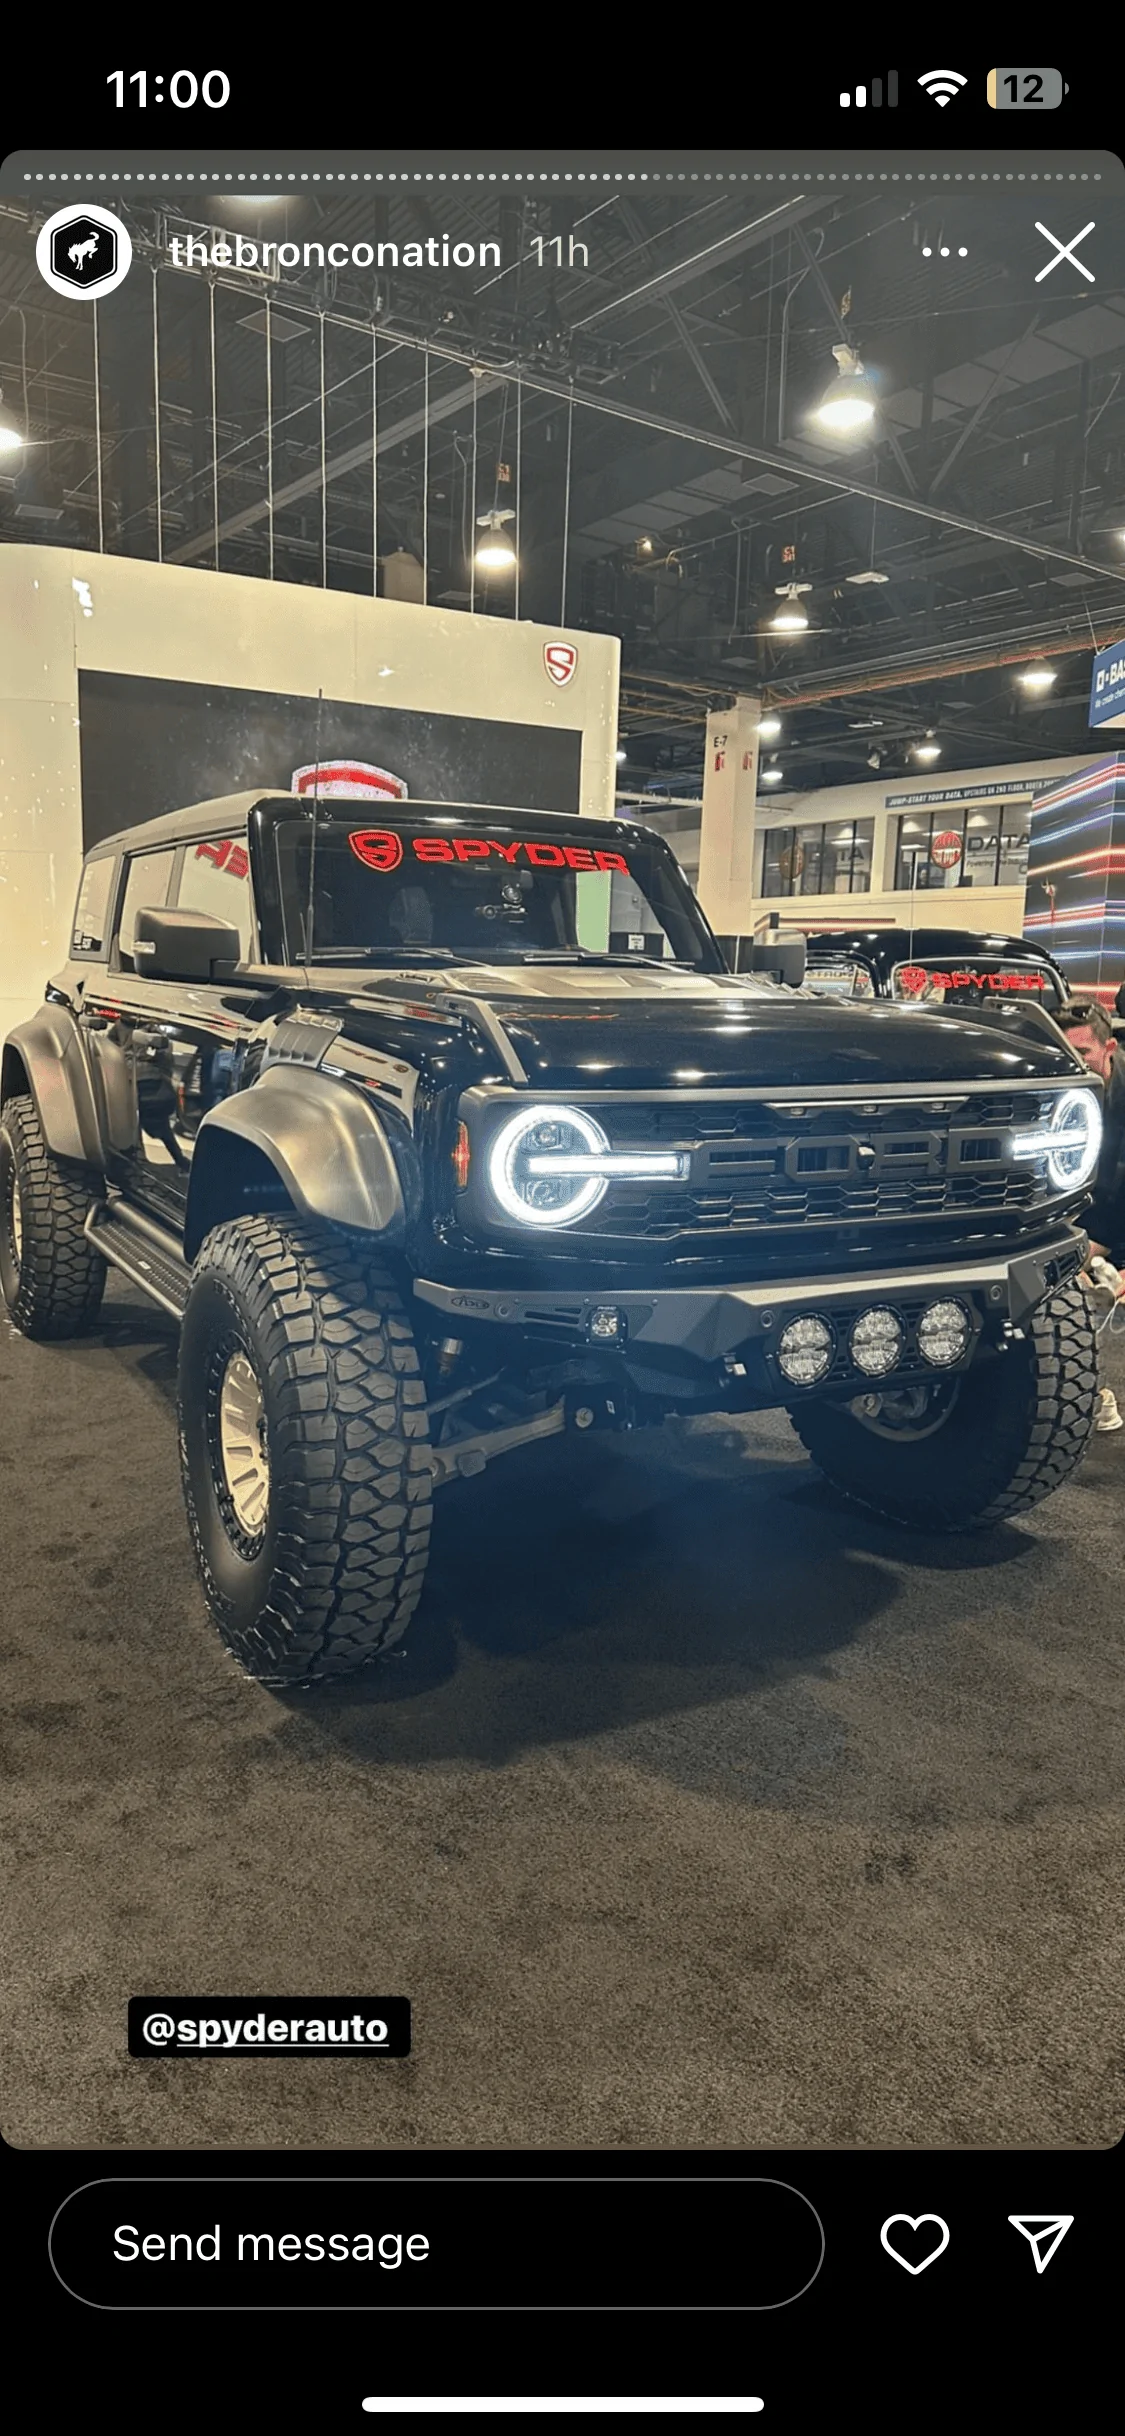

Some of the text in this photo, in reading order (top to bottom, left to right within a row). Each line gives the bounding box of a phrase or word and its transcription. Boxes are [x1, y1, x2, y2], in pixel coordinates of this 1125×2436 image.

[713, 735, 728, 748] E-7
[889, 794, 927, 806] JUMP-START
[928, 792, 944, 801] YOUR
[996, 784, 1007, 793] 2ND
[967, 832, 1030, 851] DATA
[412, 838, 631, 876] SPYDER
[931, 971, 1045, 991] SPYDER
[692, 1127, 1016, 1187] FORD
